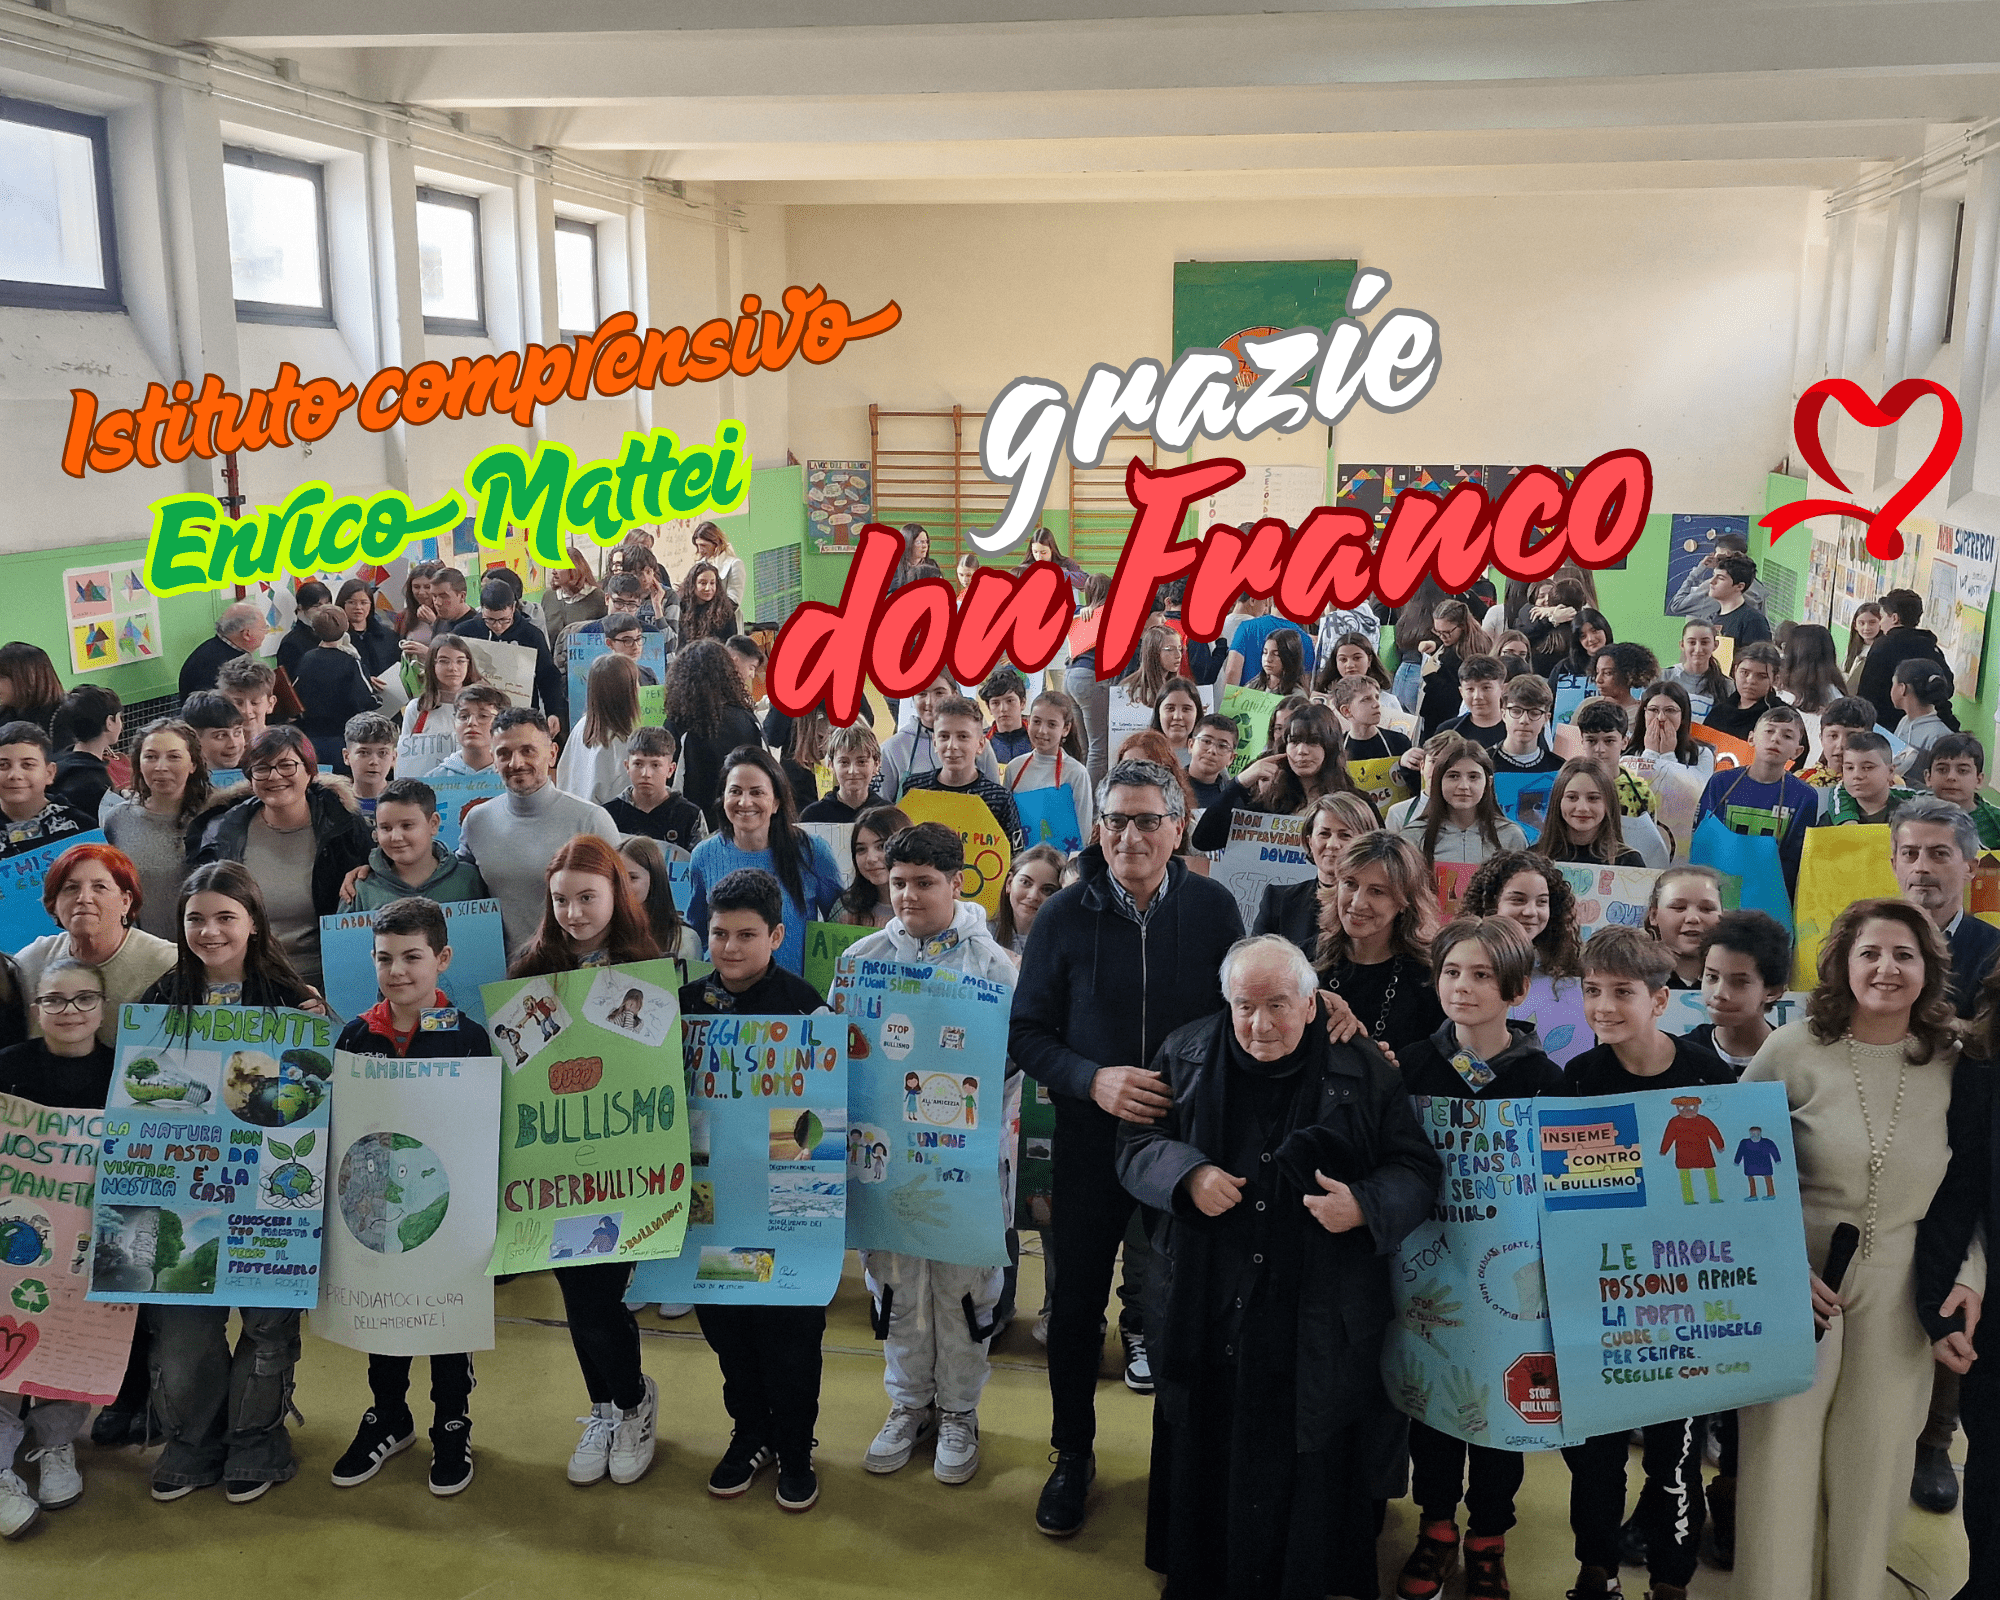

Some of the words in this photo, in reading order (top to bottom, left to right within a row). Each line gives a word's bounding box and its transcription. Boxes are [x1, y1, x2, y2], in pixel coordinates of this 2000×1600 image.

[1233, 811, 1263, 828] NON
[973, 832, 1000, 846] PLAY
[836, 958, 856, 975] LE
[801, 1020, 822, 1046] IL
[887, 1024, 909, 1034] STOP
[883, 1041, 910, 1049] BULLISMO
[350, 1056, 462, 1080] L'AMBIENTE
[744, 1046, 776, 1073] SUO
[784, 1046, 837, 1072] UNICO
[514, 1084, 675, 1149] BULLISMO
[106, 1121, 131, 1136] LA
[140, 1122, 222, 1144] NATURA
[229, 1129, 263, 1146] NON
[1543, 1128, 1611, 1145] INSIEME
[127, 1143, 153, 1160] UN
[164, 1143, 220, 1162] POSTO
[227, 1147, 259, 1165] DA
[574, 1144, 601, 1167] e
[1572, 1150, 1642, 1168] CONTRO
[220, 1166, 249, 1186] LA
[1544, 1180, 1558, 1192] IL
[1561, 1174, 1637, 1192] BULLISMO
[101, 1177, 177, 1197] NOSTRA
[189, 1183, 236, 1204] CASA
[504, 1162, 686, 1213] CYBERBULLISMO
[228, 1214, 292, 1227] CONOSCERE
[229, 1226, 254, 1236] TUO
[252, 1236, 288, 1248] PASSO
[1402, 1232, 1452, 1283] STOP!
[1600, 1243, 1638, 1272] LE
[1652, 1240, 1736, 1269] PAROLE
[1599, 1273, 1689, 1302] POSSONO
[1697, 1266, 1759, 1290] APRIRE
[325, 1283, 420, 1309] PRENDIAMOCI
[424, 1292, 464, 1308] CURA
[1602, 1305, 1627, 1327] LA
[1702, 1299, 1742, 1322] DEL
[1600, 1327, 1653, 1348] CUORE
[1602, 1348, 1633, 1366] PER
[1677, 1365, 1710, 1379] CON
[1528, 1387, 1551, 1400] STOP
